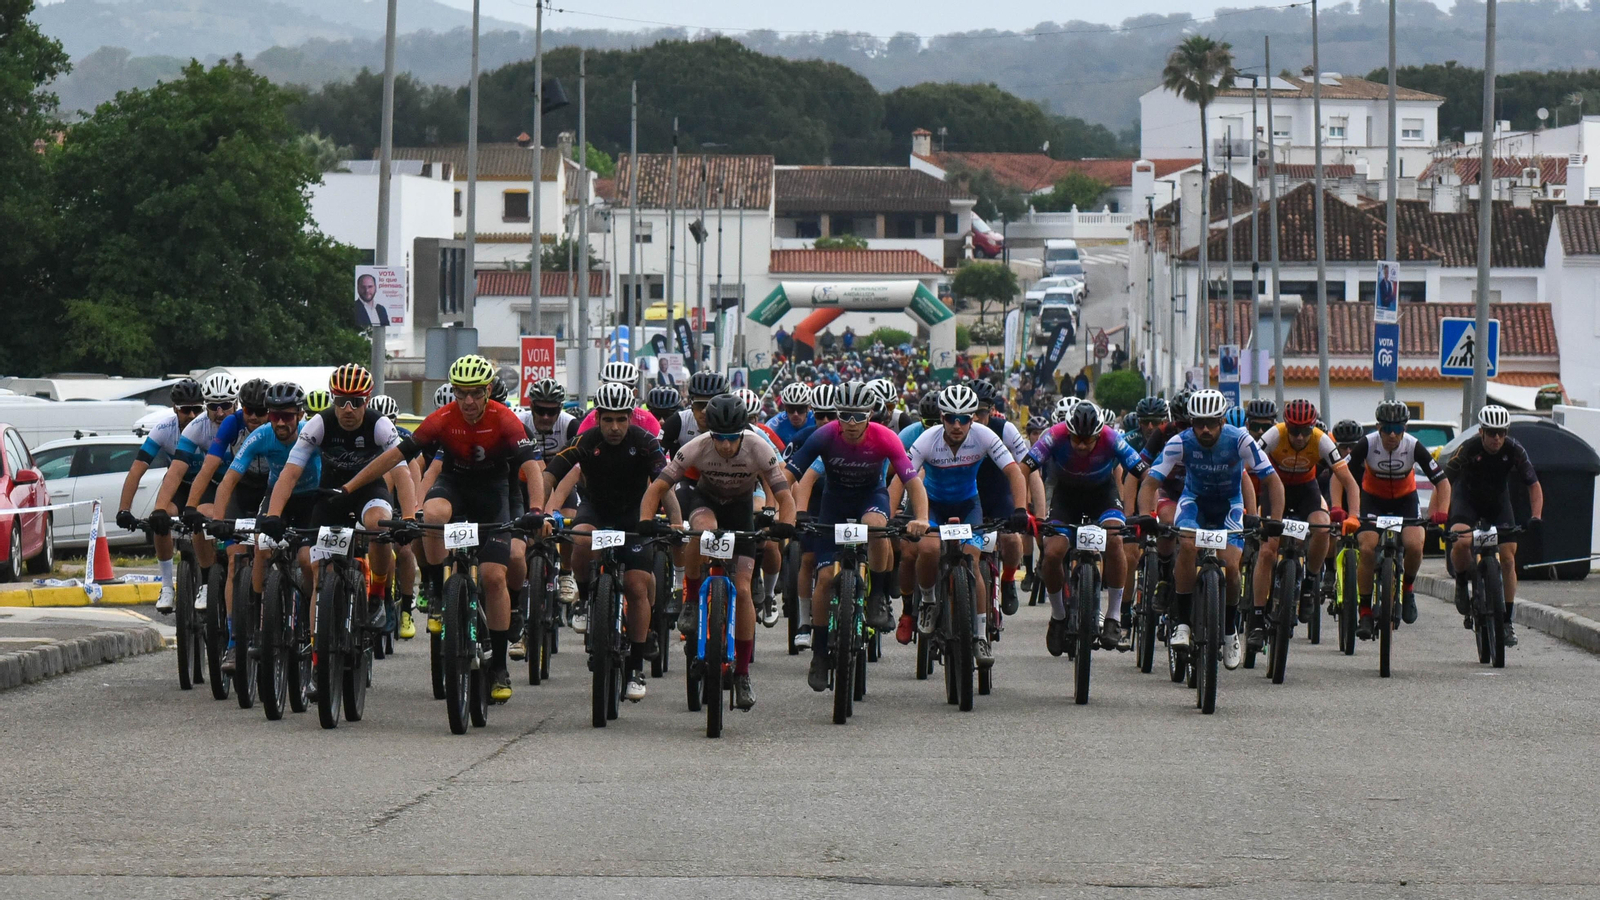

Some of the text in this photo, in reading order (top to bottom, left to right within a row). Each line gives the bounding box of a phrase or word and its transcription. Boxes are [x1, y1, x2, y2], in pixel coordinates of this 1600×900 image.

[1378, 338, 1394, 347] VOTA
[527, 348, 550, 362] VOTA
[523, 365, 552, 380] PSOE
[930, 453, 981, 465] desnivelzero
[843, 526, 859, 538] 61
[943, 527, 969, 538] 453
[1284, 521, 1305, 533] 189
[320, 533, 347, 549] 436
[448, 528, 475, 541] 491
[595, 534, 622, 547] 336
[1079, 532, 1104, 545] 523
[1200, 531, 1223, 543] 126
[704, 537, 730, 552] 185
